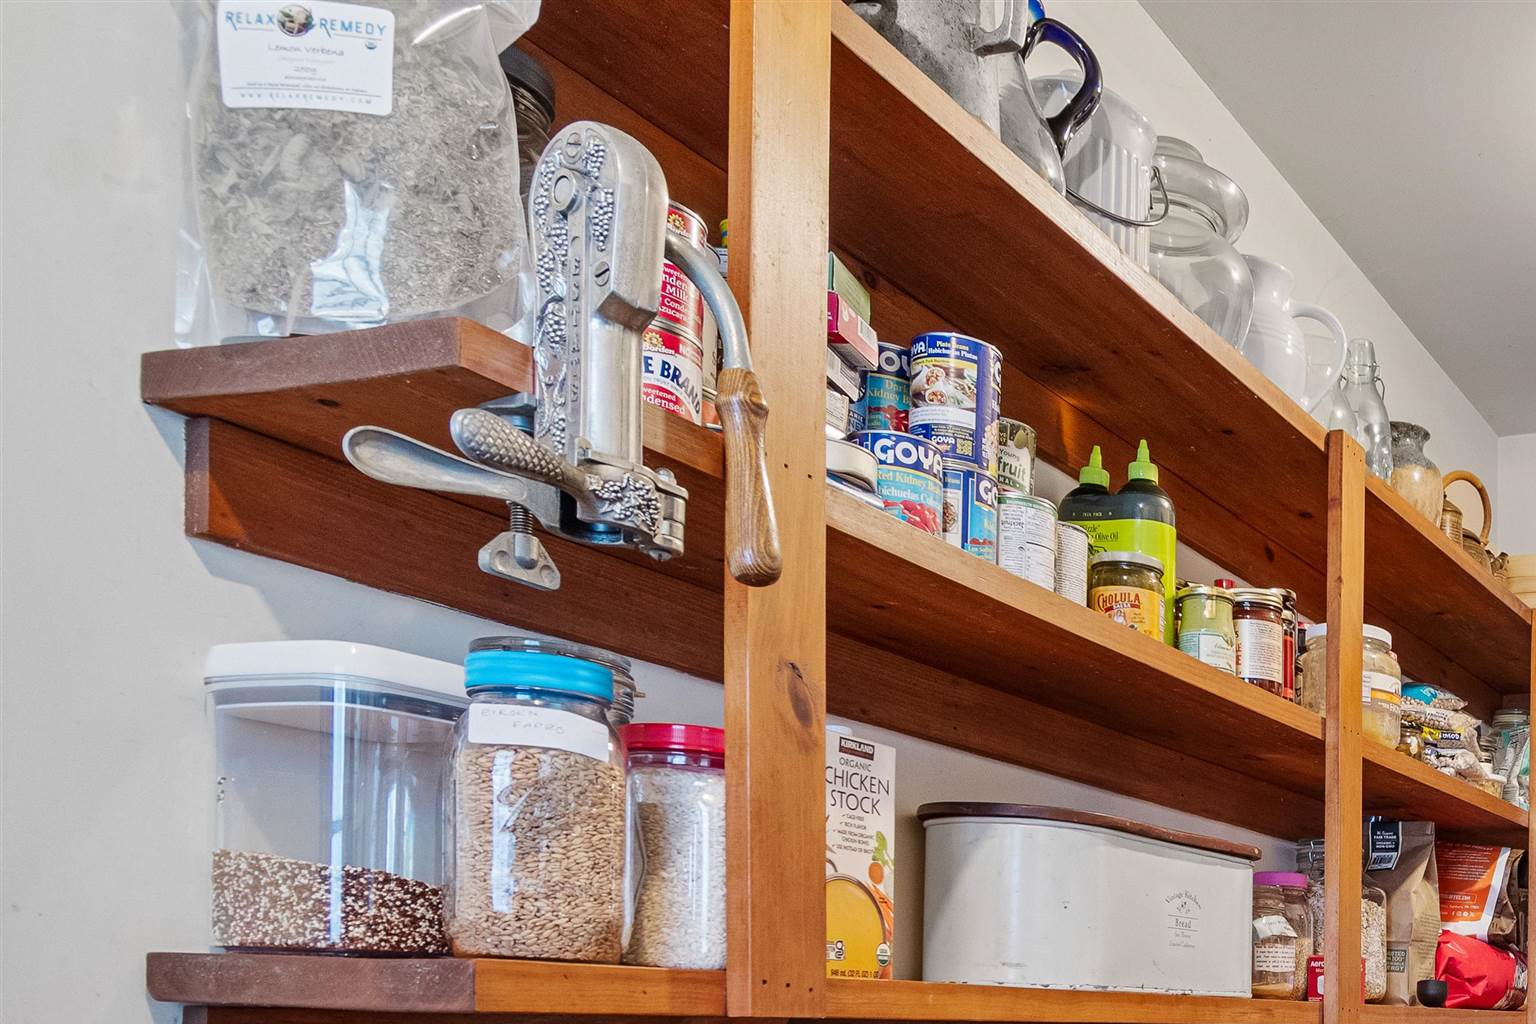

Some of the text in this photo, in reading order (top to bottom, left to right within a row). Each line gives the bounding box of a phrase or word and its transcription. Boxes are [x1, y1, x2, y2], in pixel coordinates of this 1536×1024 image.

[225, 11, 387, 38] RELAX REMEDY
[643, 386, 676, 402] weetened
[660, 359, 700, 414] BRAND
[931, 436, 955, 445] GOYA
[874, 438, 943, 481] GOYA
[998, 456, 1026, 481] fruit
[895, 472, 927, 488] Kidney
[1110, 532, 1119, 541] Oil
[1098, 592, 1140, 611] CHOLULA
[841, 739, 873, 753] KIRKLAND
[839, 757, 872, 772] ORGANIC
[825, 766, 890, 796] CHICKEN
[830, 789, 881, 816] STOCK
[1175, 918, 1191, 928] Bread
